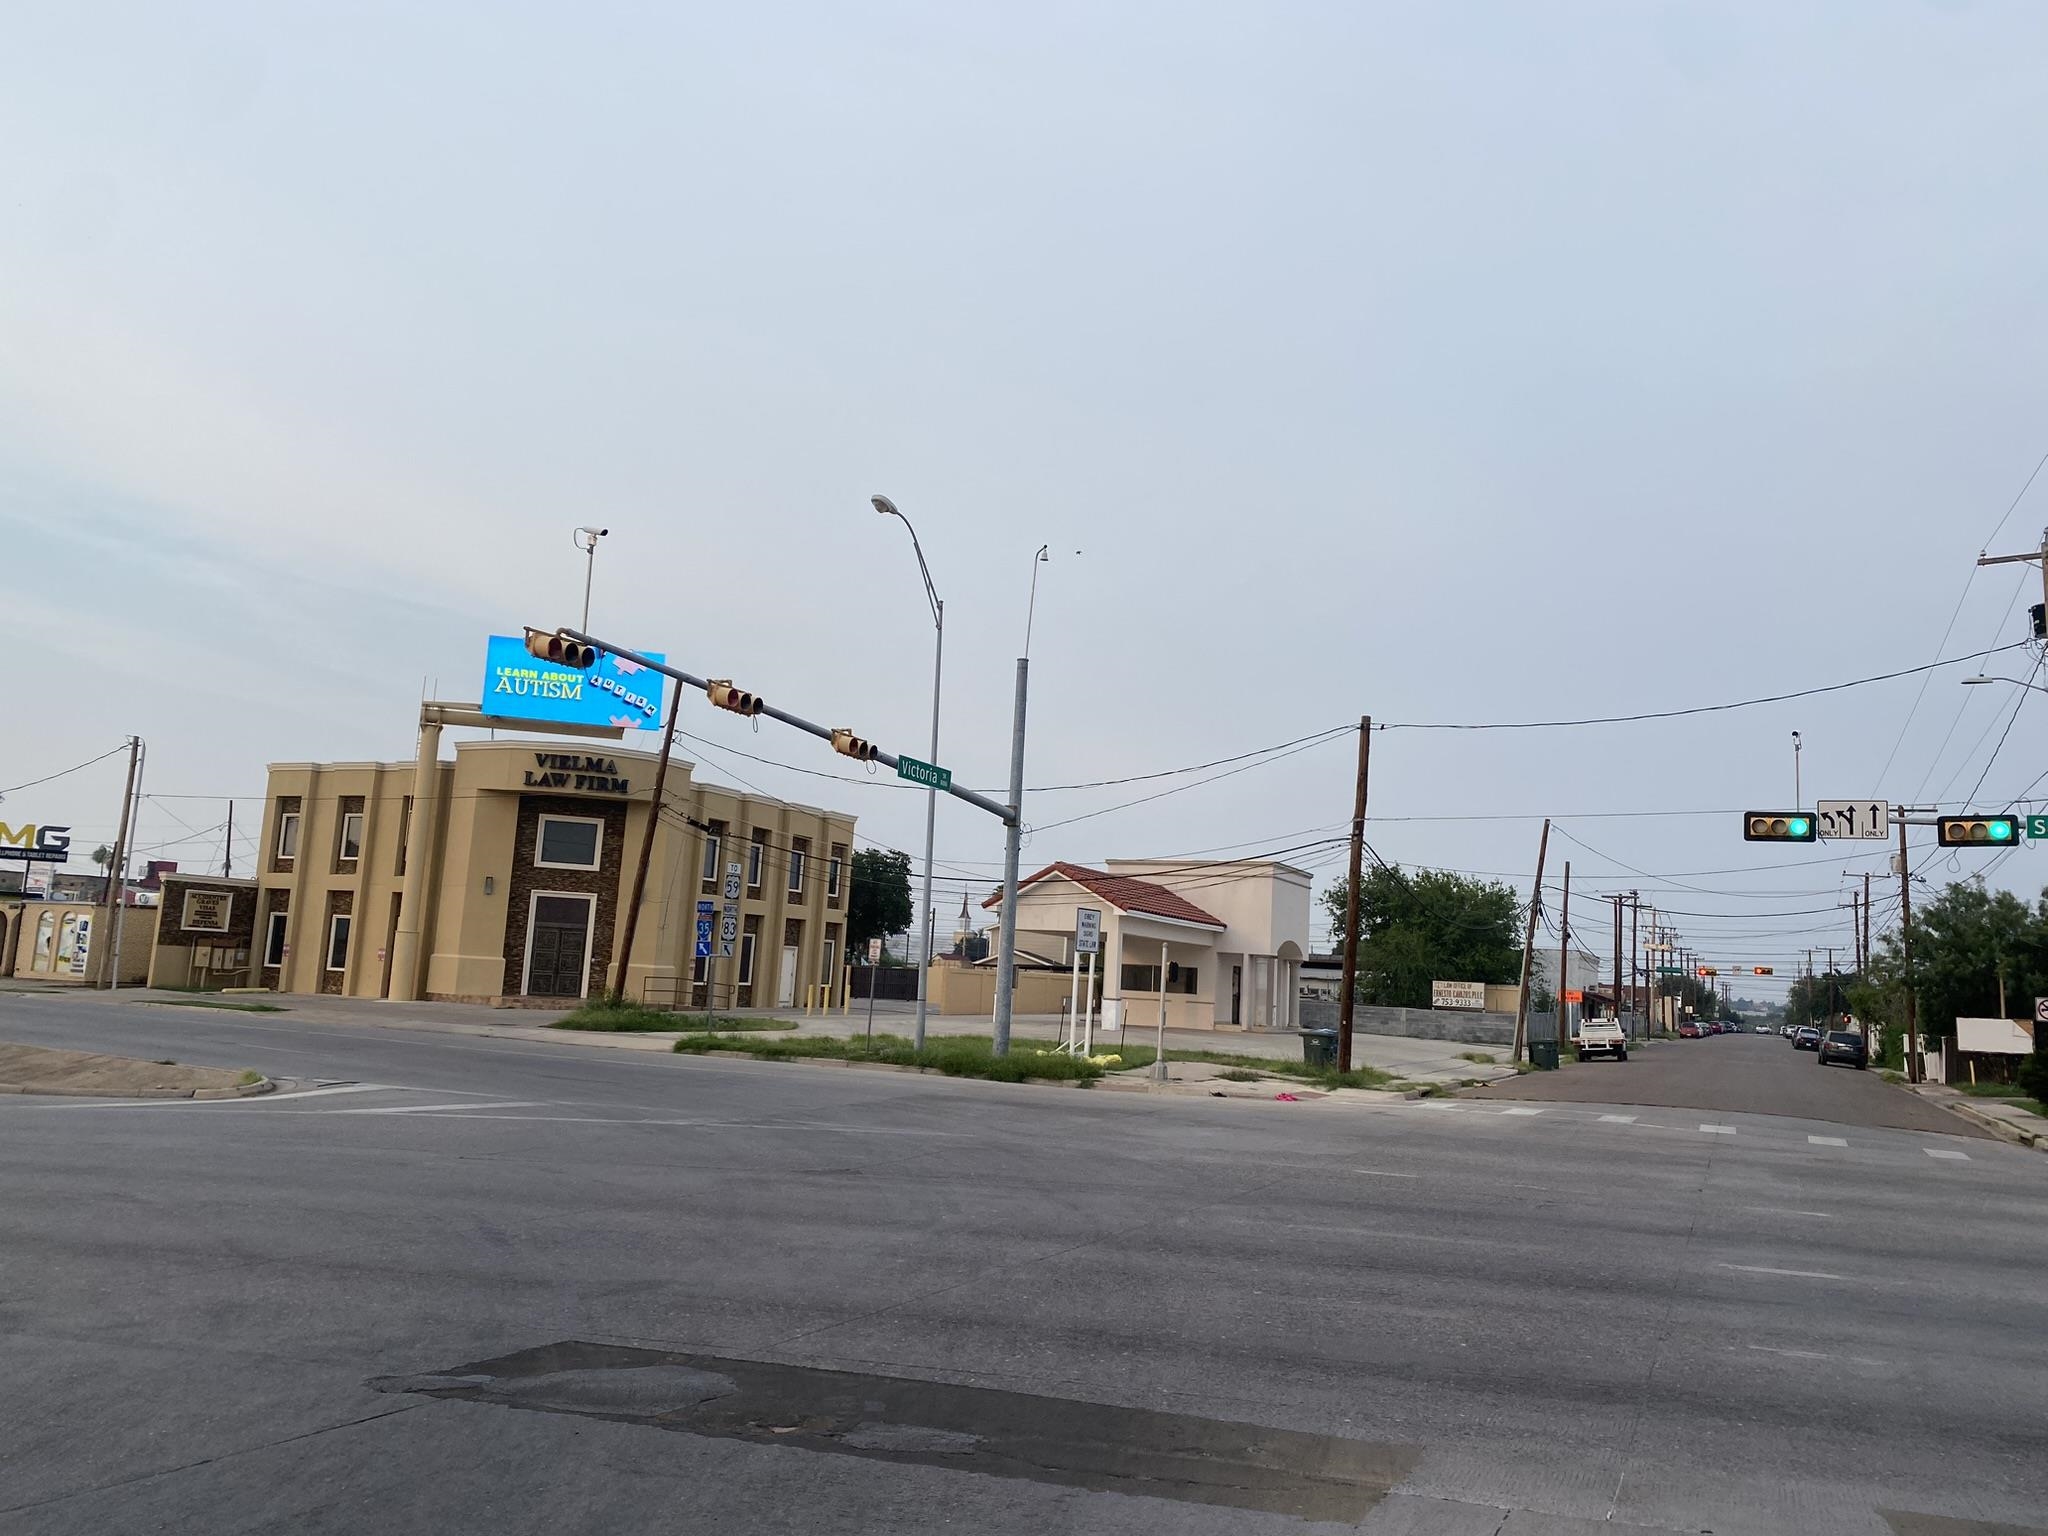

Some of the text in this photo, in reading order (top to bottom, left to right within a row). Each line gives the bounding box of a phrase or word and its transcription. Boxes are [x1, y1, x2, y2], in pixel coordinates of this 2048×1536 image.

[496, 666, 584, 684] LEARN ABOUT
[494, 676, 583, 701] AUTISM
[535, 753, 618, 775] VIELMA
[902, 760, 938, 783] Victoria
[523, 771, 630, 794] LAW FIRM
[731, 864, 738, 872] TO
[727, 880, 739, 893] 59
[699, 922, 710, 935] 35
[723, 922, 736, 936] 83
